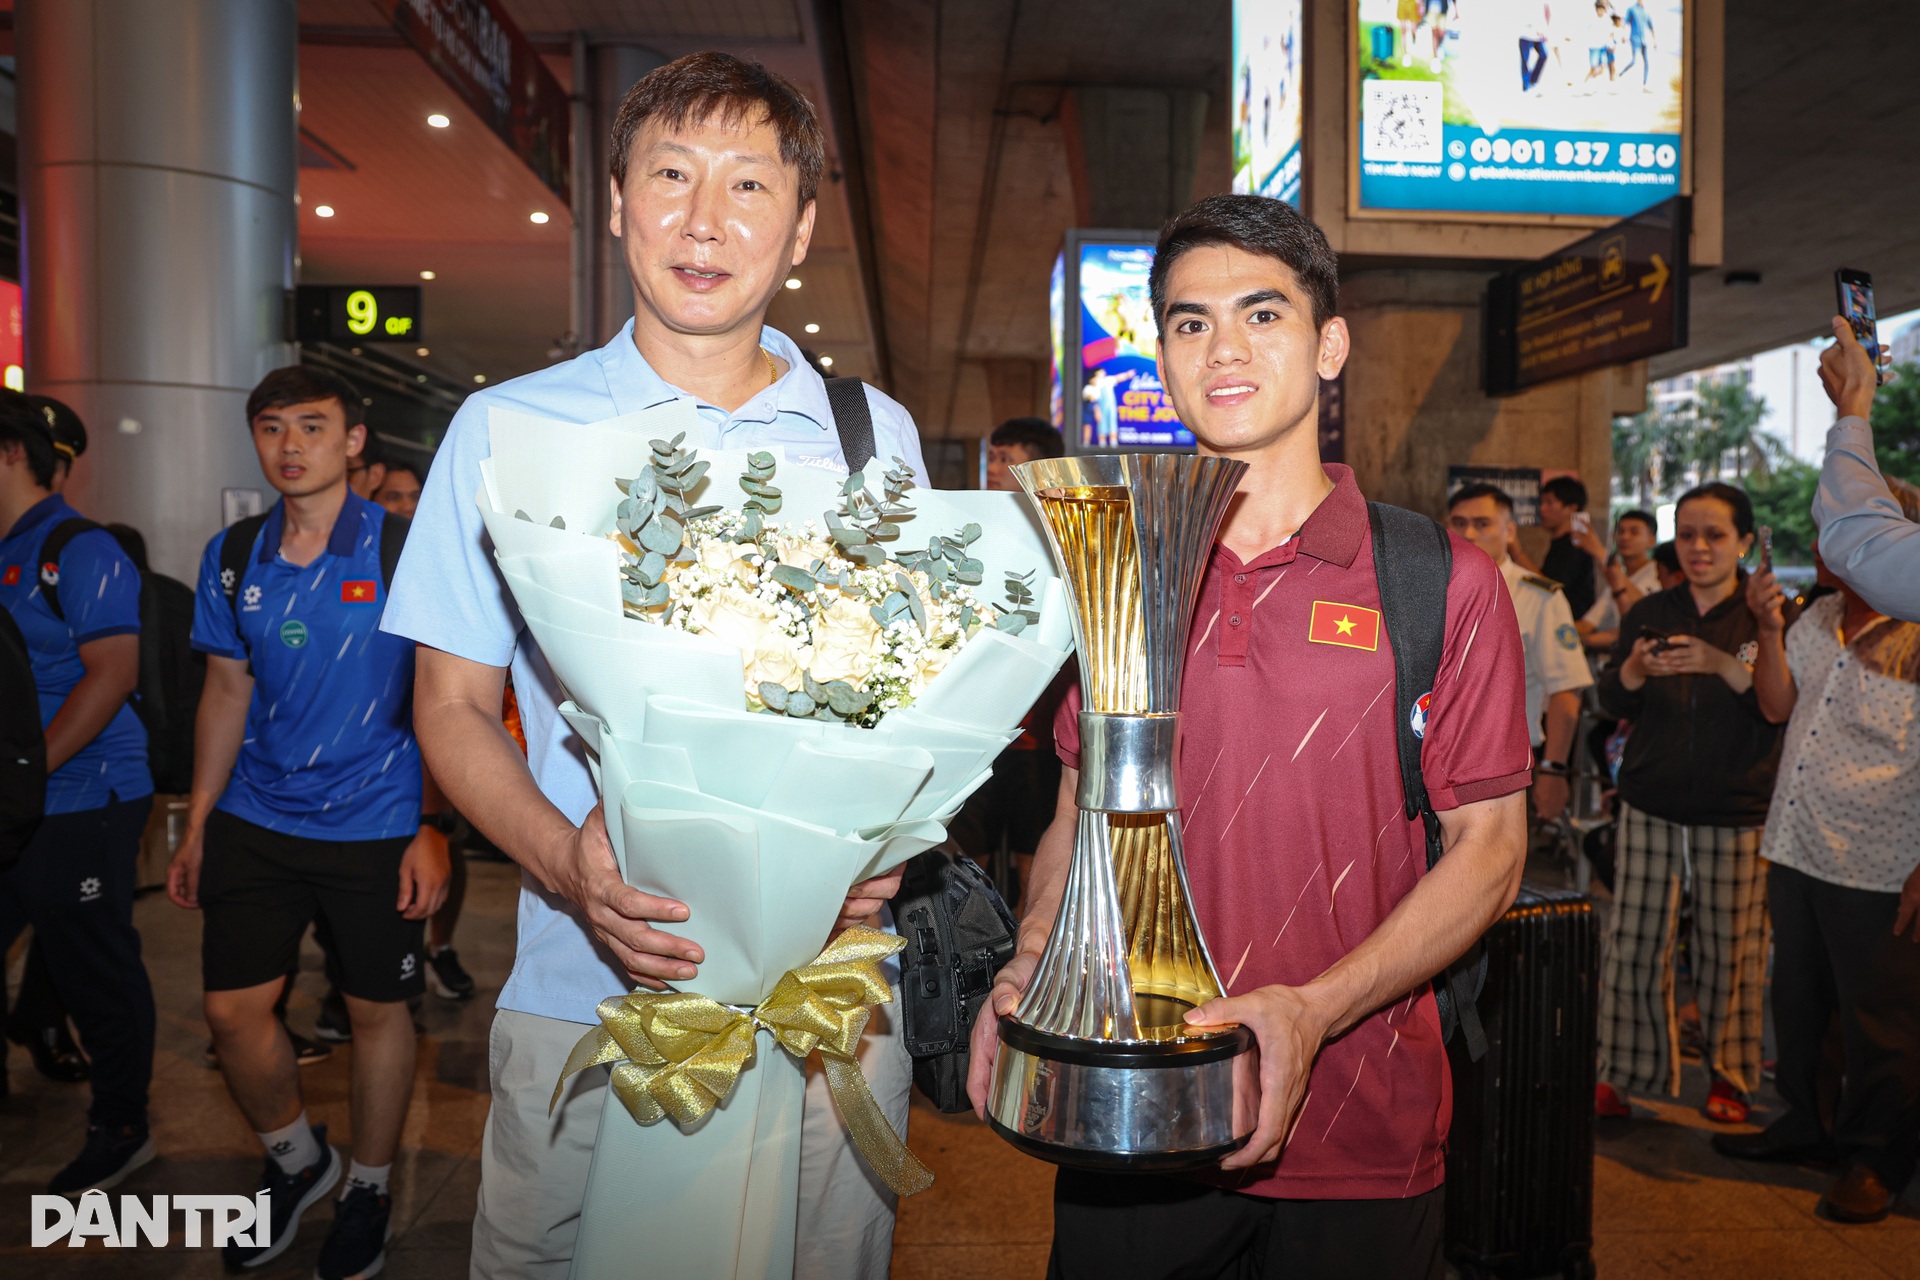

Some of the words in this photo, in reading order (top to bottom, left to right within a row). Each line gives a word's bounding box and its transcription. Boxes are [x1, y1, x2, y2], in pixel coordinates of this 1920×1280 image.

[1470, 137, 1545, 164] 0901
[1554, 140, 1609, 166] 937
[1618, 143, 1677, 169] 550
[346, 290, 377, 335] 9
[1122, 390, 1161, 407] CITY
[1117, 405, 1150, 422] THE
[918, 1040, 950, 1052] TUMI
